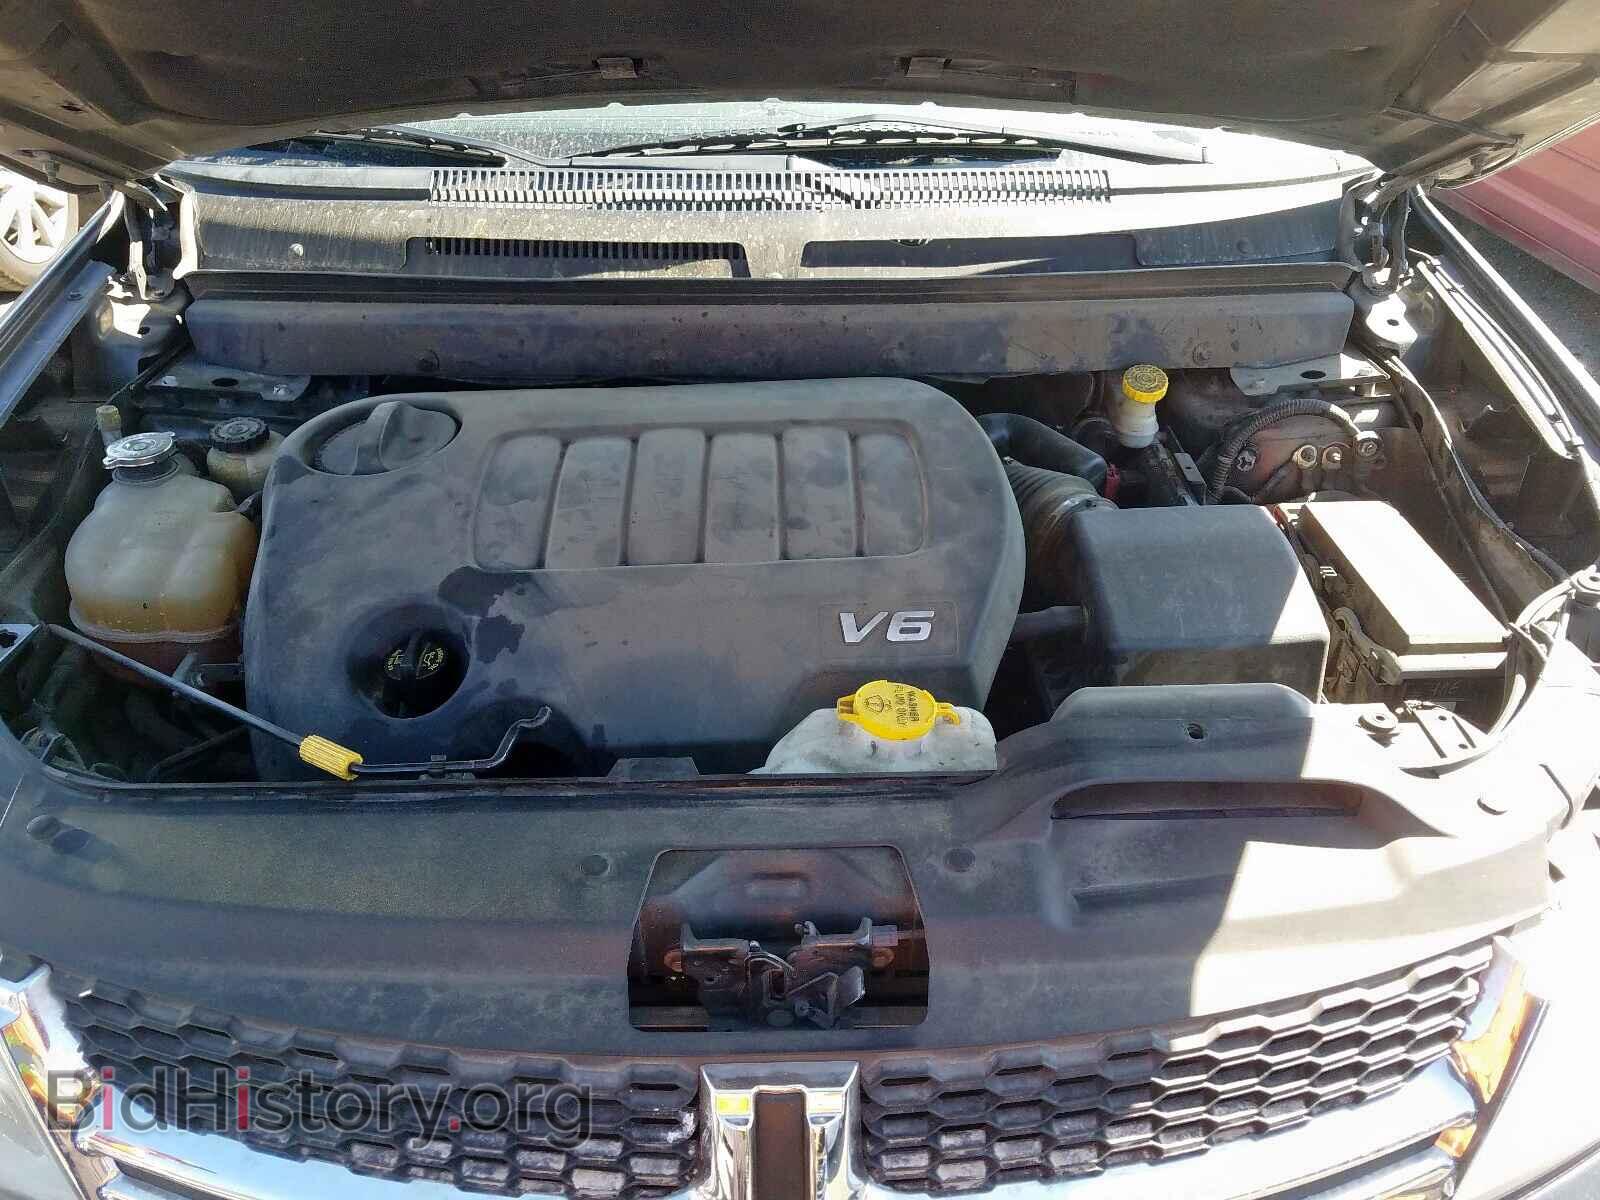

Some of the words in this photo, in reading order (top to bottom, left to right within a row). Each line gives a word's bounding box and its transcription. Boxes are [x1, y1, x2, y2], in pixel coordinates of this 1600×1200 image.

[839, 610, 935, 643] V6
[894, 684, 906, 706] FLUID
[906, 689, 920, 722] WASHER
[896, 706, 908, 727] ONLY
